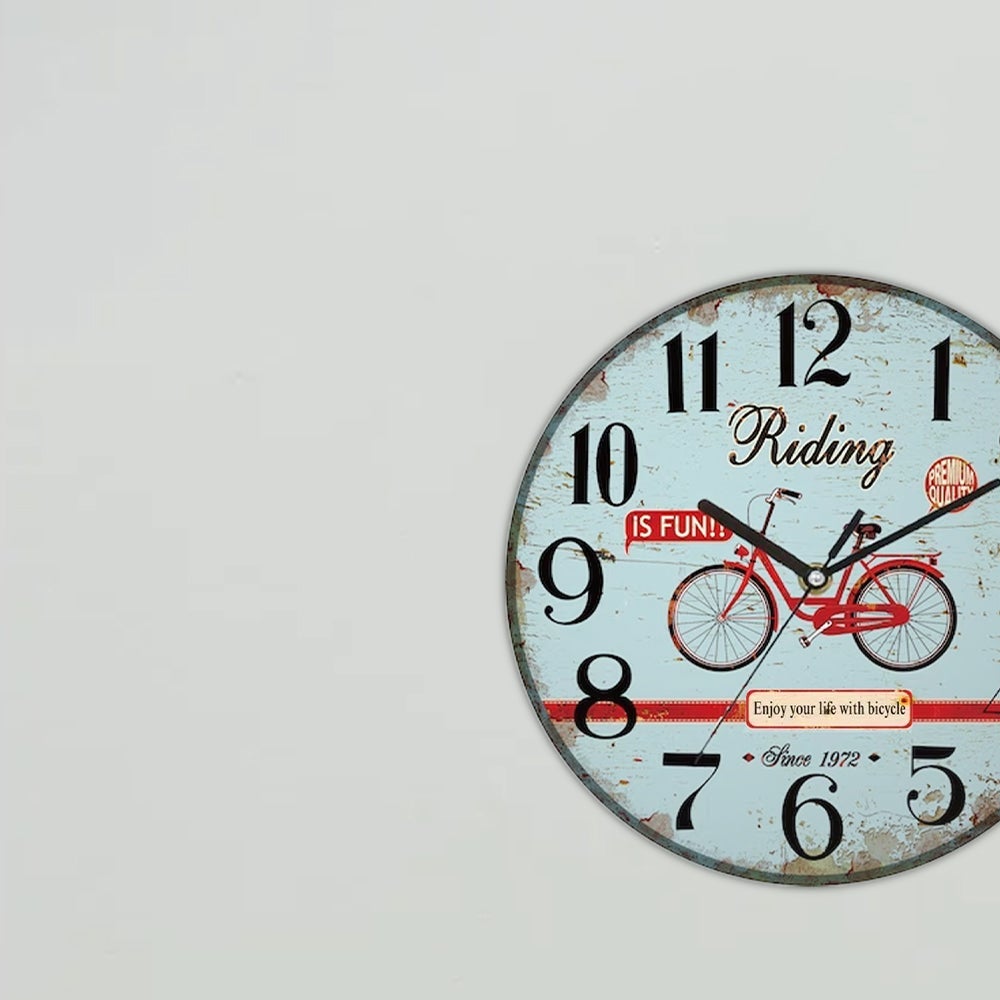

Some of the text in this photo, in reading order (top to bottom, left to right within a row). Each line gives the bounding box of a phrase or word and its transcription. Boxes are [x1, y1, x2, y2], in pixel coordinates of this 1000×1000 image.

[663, 331, 719, 413] 11
[777, 298, 851, 387] 12
[931, 336, 951, 421] 1
[571, 423, 638, 506] 10
[728, 404, 896, 489] Riding
[928, 458, 975, 487] PREMIUM
[632, 515, 653, 538] IS
[538, 537, 605, 625] 9
[575, 654, 632, 739] 8
[753, 700, 906, 719] Enjoy your life with bicycle
[663, 750, 721, 831] 7
[761, 743, 861, 768] Since 1972
[907, 746, 966, 826] 5
[781, 774, 844, 860] 6
